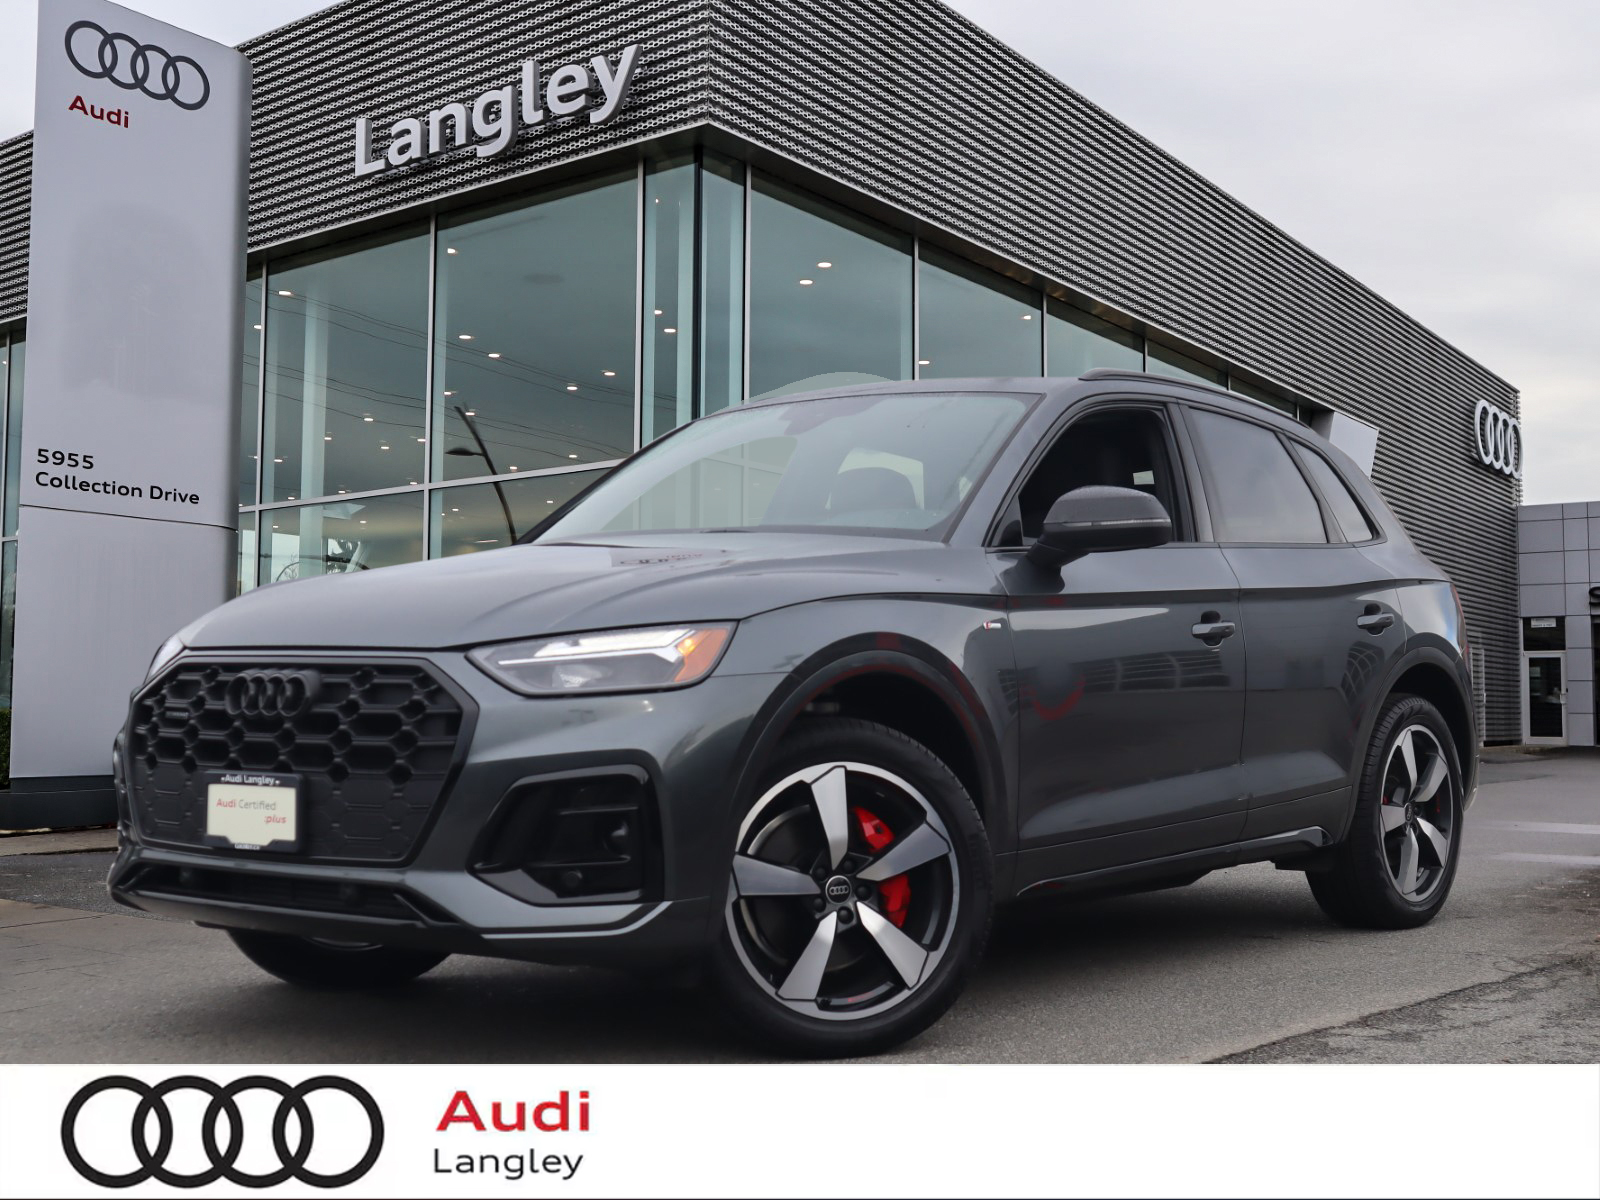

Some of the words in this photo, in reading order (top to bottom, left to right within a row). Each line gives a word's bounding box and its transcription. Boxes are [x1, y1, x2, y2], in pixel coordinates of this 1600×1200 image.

[68, 95, 129, 128] Audi
[354, 44, 643, 177] Langley
[37, 448, 94, 469] 5955
[35, 471, 143, 498] Collection
[150, 485, 200, 504] Drive
[225, 774, 242, 783] Audi
[243, 775, 275, 786] Langley
[216, 798, 236, 808] Audi
[238, 799, 277, 811] Certified
